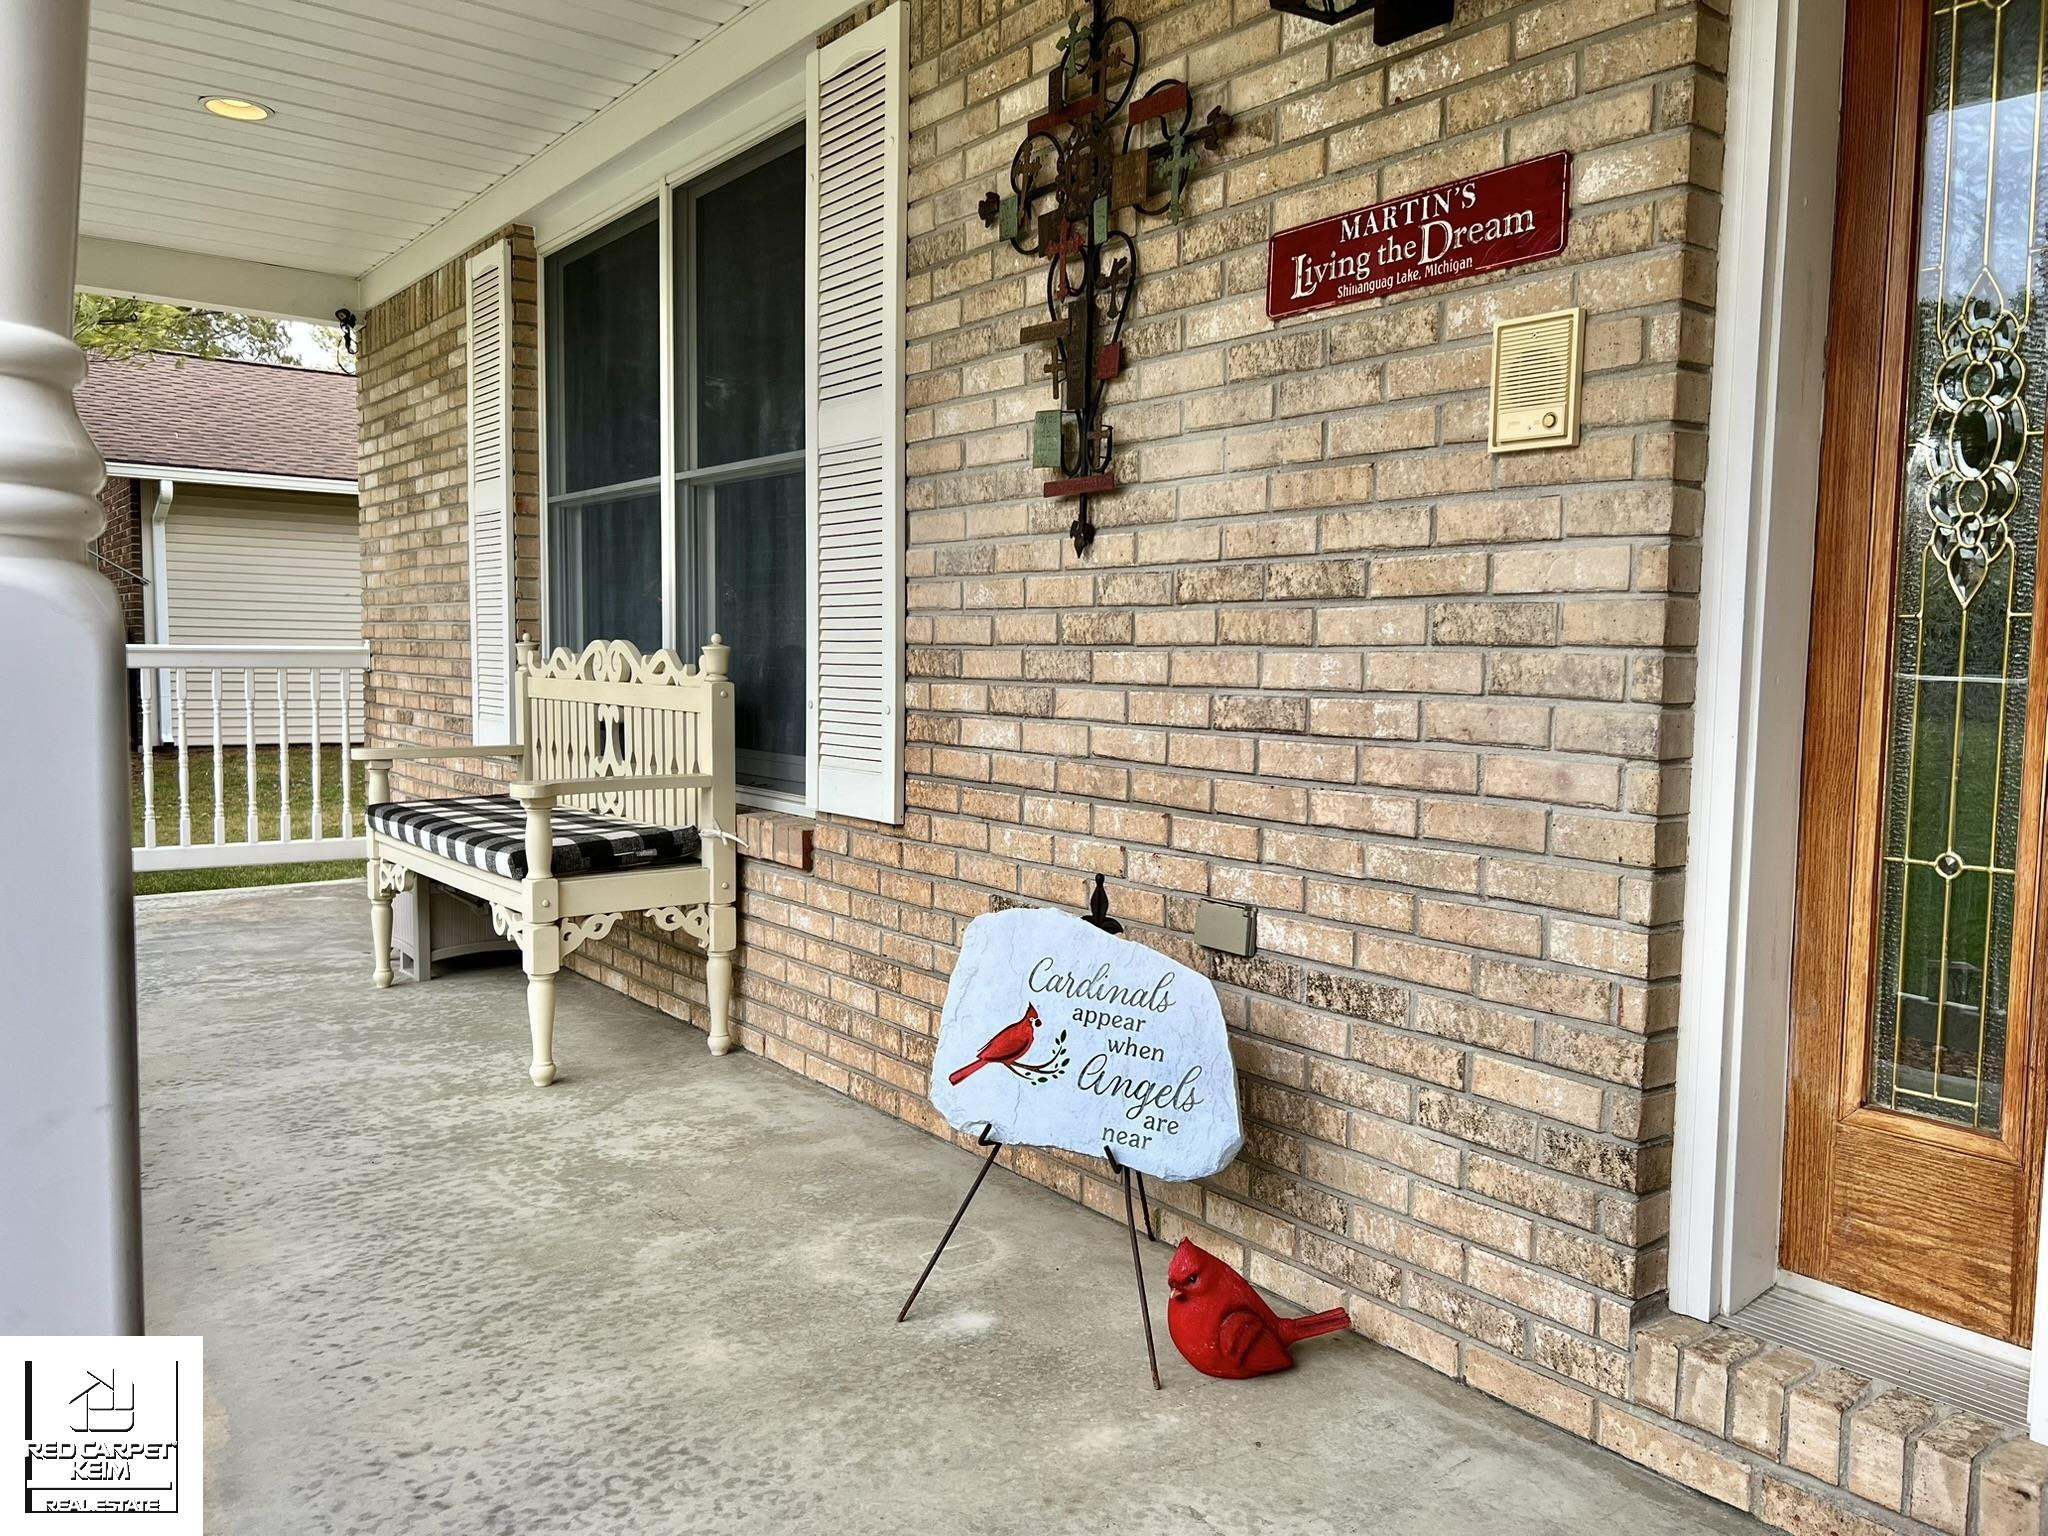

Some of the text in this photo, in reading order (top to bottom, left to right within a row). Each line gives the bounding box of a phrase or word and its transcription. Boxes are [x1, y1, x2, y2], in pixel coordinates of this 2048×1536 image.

[1339, 182, 1477, 243] MARTIN'S
[1290, 208, 1536, 300] Living the Dream
[1396, 268, 1422, 286] Lake,
[1028, 957, 1176, 1013] Cardinals
[1072, 1007, 1146, 1033] appear
[1107, 1037, 1164, 1062] when
[1077, 1054, 1204, 1119] Angels
[1102, 1125, 1153, 1150] near
[1143, 1115, 1179, 1135] are
